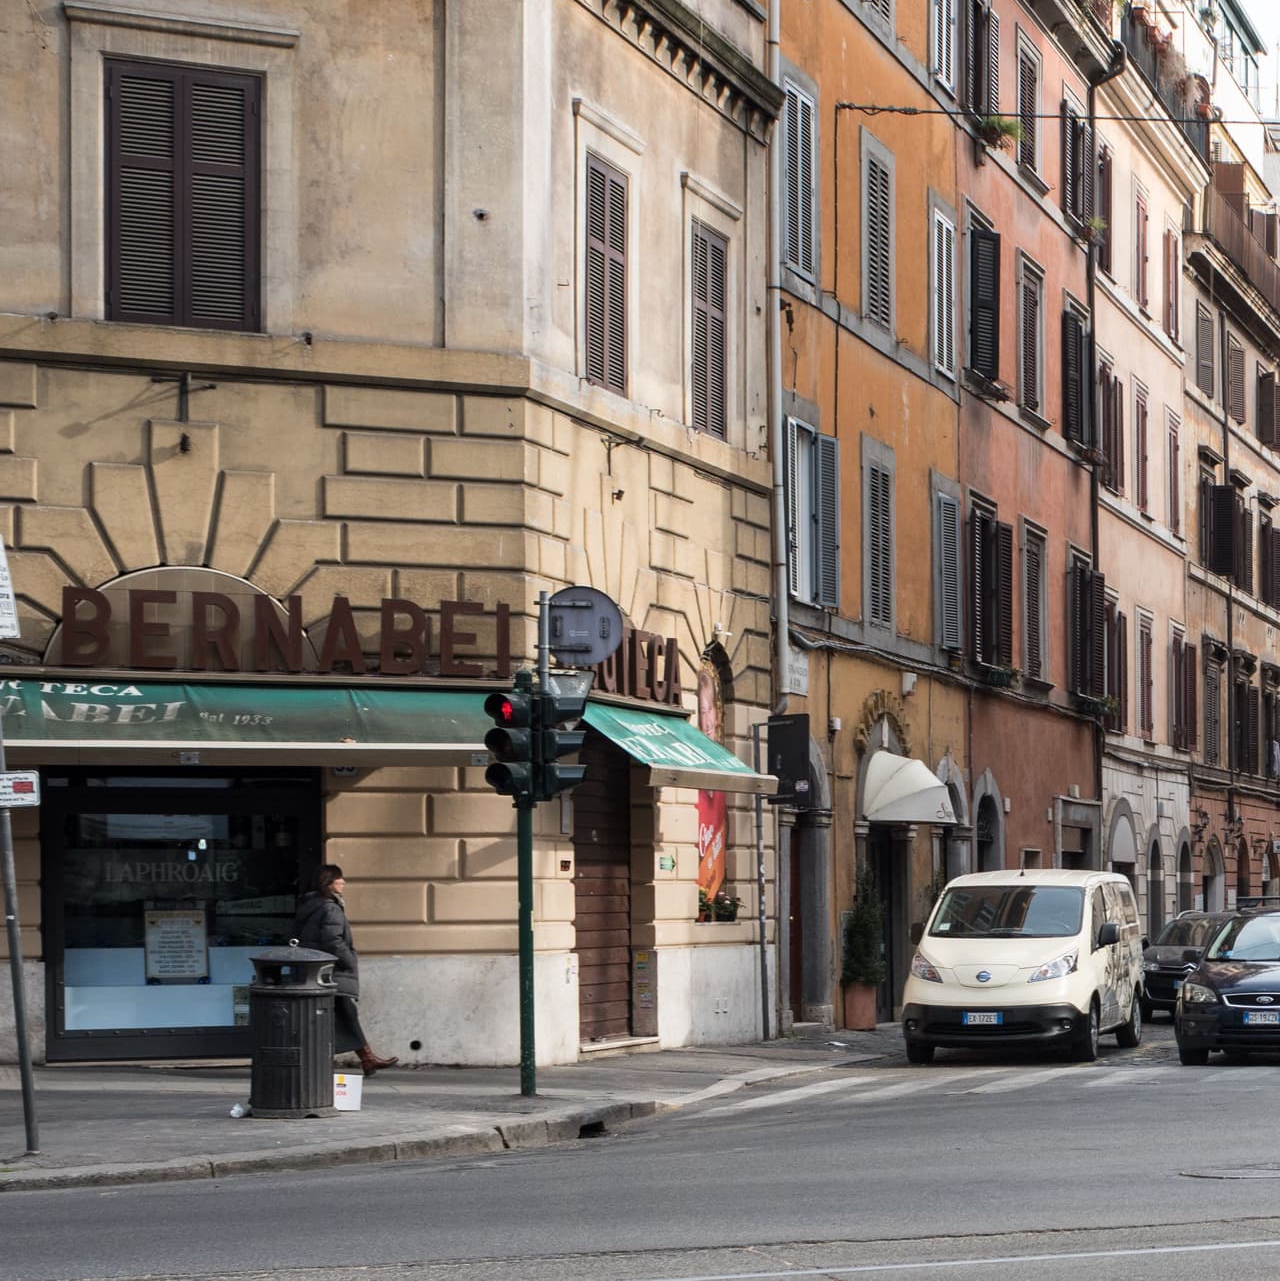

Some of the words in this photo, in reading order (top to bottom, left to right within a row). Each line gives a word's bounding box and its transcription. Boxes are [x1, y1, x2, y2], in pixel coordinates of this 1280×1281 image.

[62, 585, 511, 679] BERNABEI
[232, 714, 273, 726] 1933
[105, 862, 239, 883] LAPHROAIG
